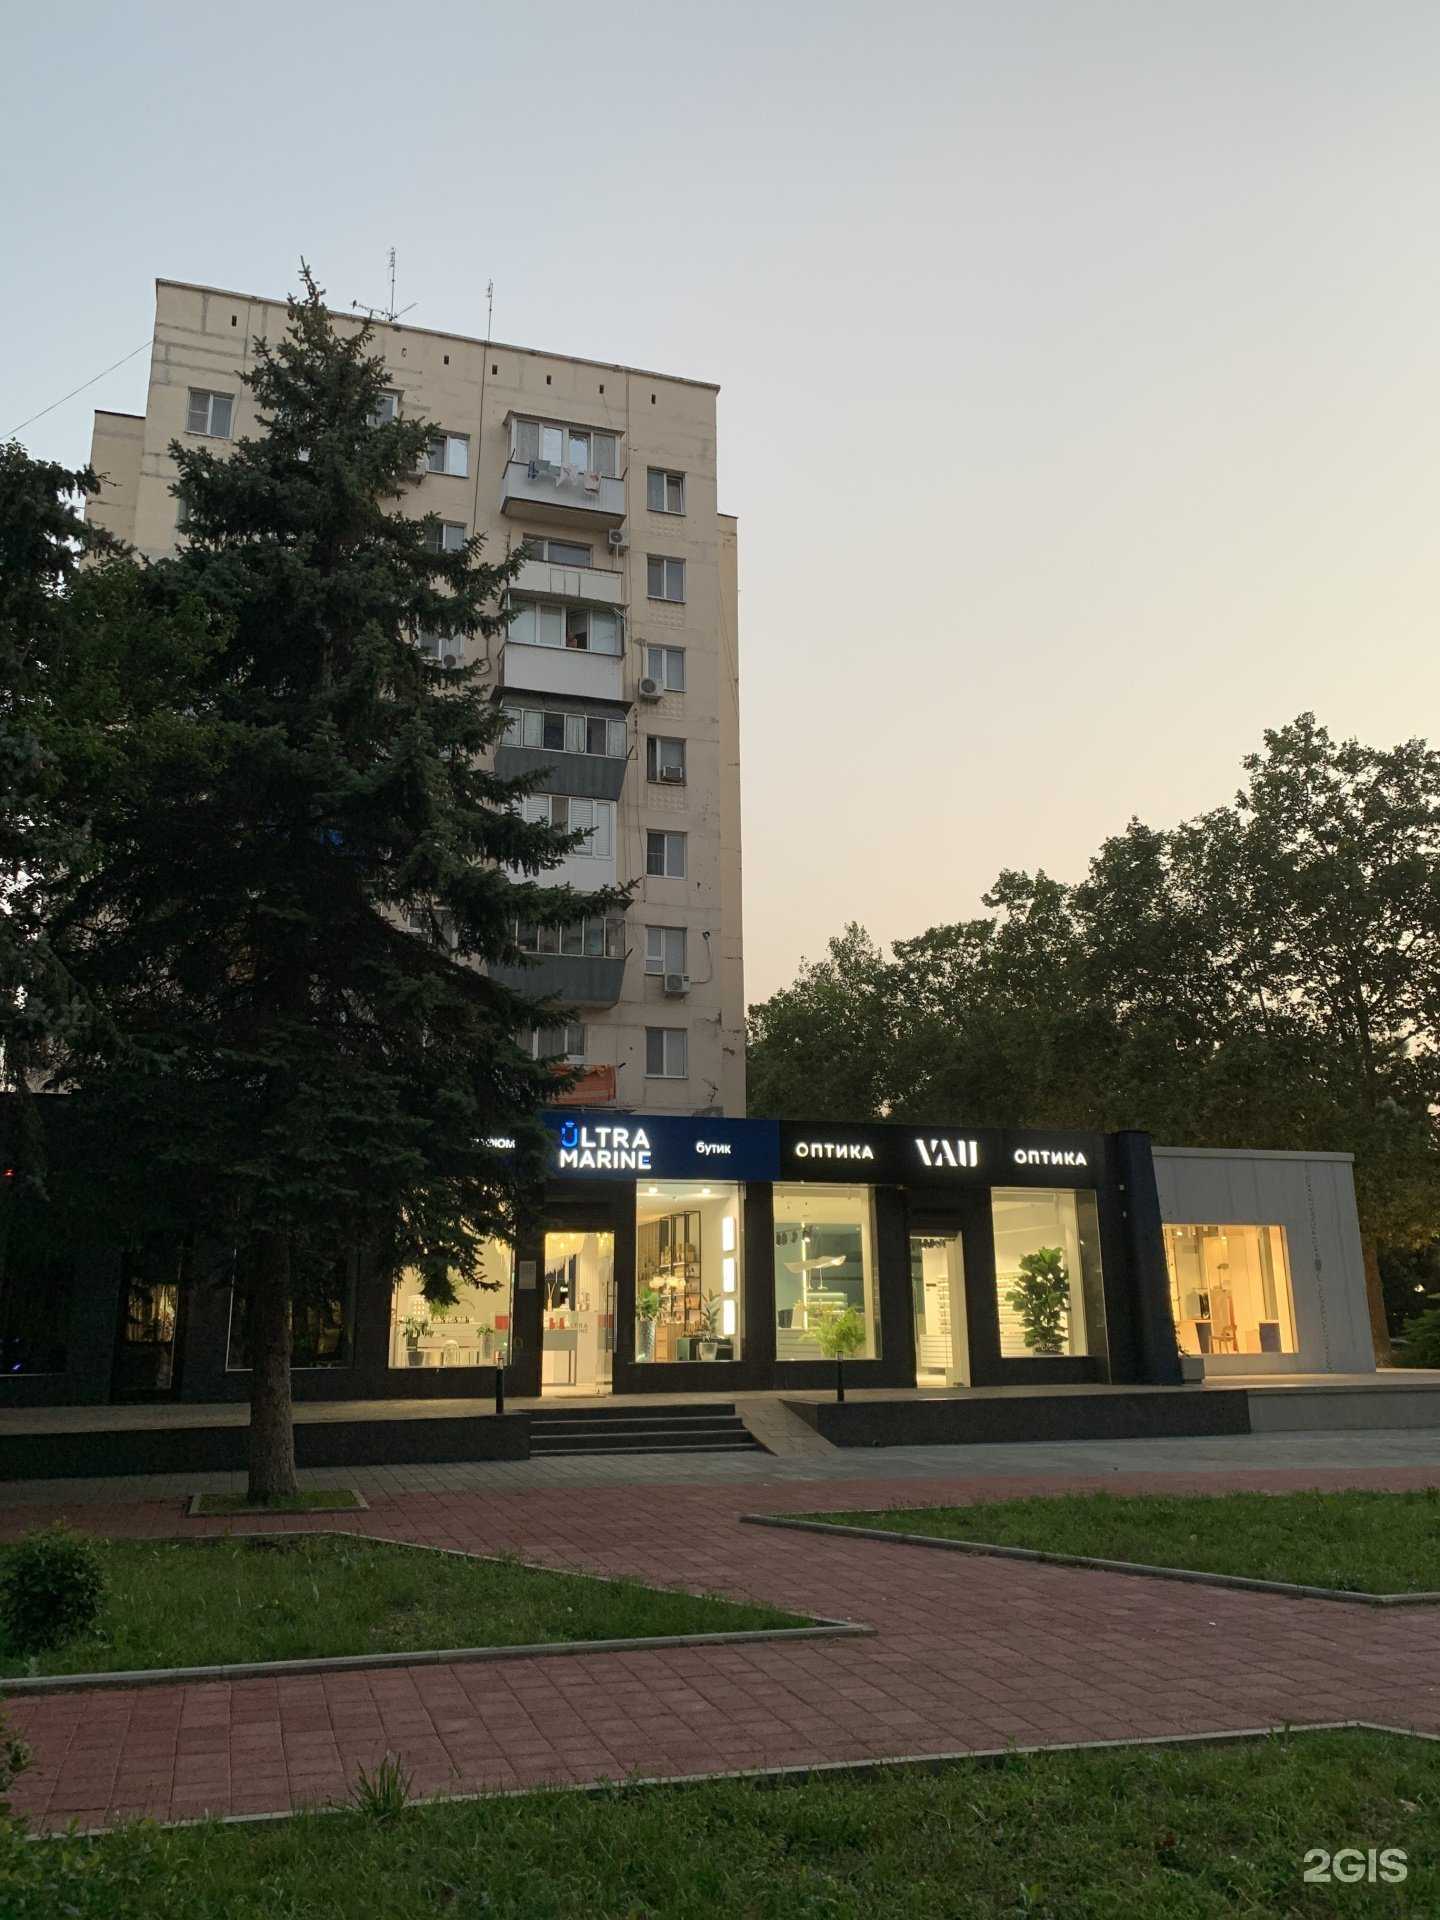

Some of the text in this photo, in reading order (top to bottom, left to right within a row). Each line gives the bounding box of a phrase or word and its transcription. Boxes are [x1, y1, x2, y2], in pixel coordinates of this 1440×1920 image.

[561, 1120, 651, 1149] ULTRA
[695, 1141, 732, 1156] бутик
[794, 1142, 875, 1160] ОПТИКА
[1013, 1148, 1088, 1167] ОПТИКА
[558, 1149, 652, 1170] MARINE
